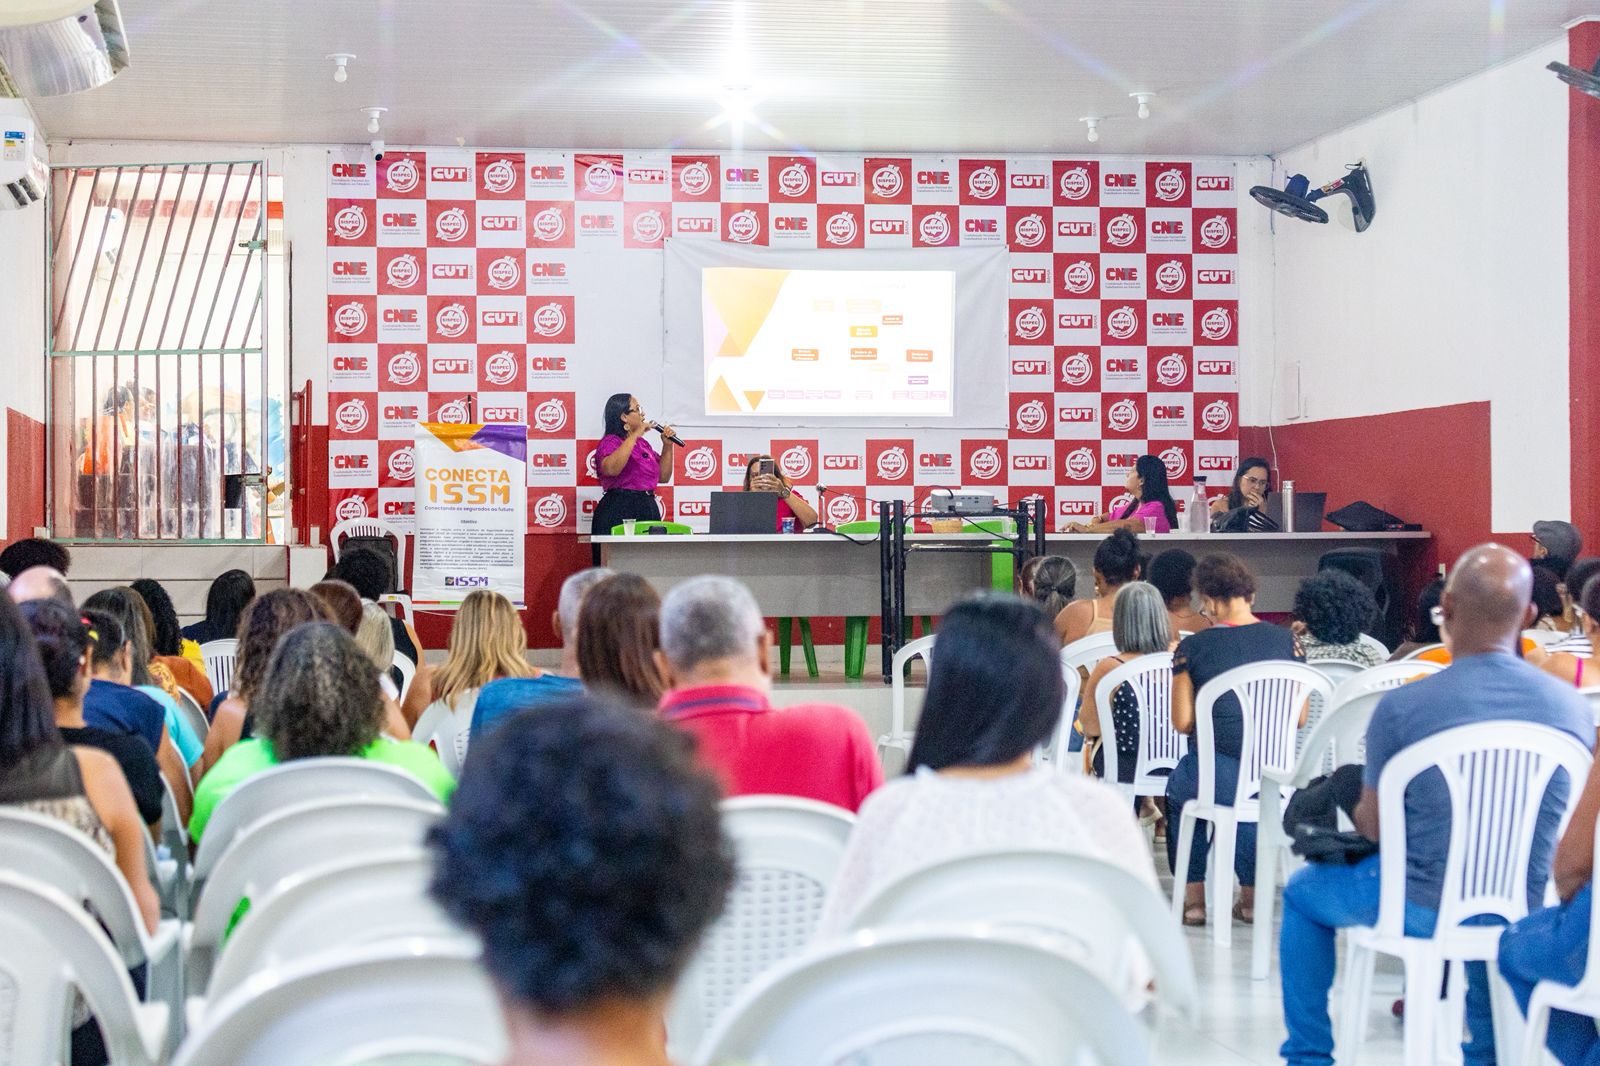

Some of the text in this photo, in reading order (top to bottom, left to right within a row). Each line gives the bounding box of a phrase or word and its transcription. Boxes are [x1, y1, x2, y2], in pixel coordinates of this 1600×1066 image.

[433, 168, 465, 179] CUT
[630, 170, 662, 182] CUT
[823, 173, 854, 184] CUT
[1012, 176, 1043, 186] CUT
[1198, 178, 1228, 188] CUT
[483, 217, 515, 228] CUT
[679, 219, 711, 230] CUT
[871, 221, 902, 232] CUT
[1060, 223, 1090, 234] CUT
[434, 265, 466, 277] CUT
[1014, 270, 1044, 281] CUT
[1199, 271, 1229, 282] CUT
[484, 312, 516, 324] CUT
[1060, 316, 1091, 326] CUT
[435, 360, 466, 371] CUT
[1014, 361, 1045, 372] CUT
[1199, 362, 1229, 373] CUT
[485, 408, 516, 420] CUT
[1061, 409, 1091, 420] CUT
[825, 456, 856, 468] CUT
[1014, 457, 1045, 468] CUT
[1200, 457, 1230, 468] CUT
[425, 468, 510, 482] CONECTA
[430, 484, 510, 504] ISSM
[1062, 502, 1092, 513] CUT
[456, 576, 488, 586] ISSM
